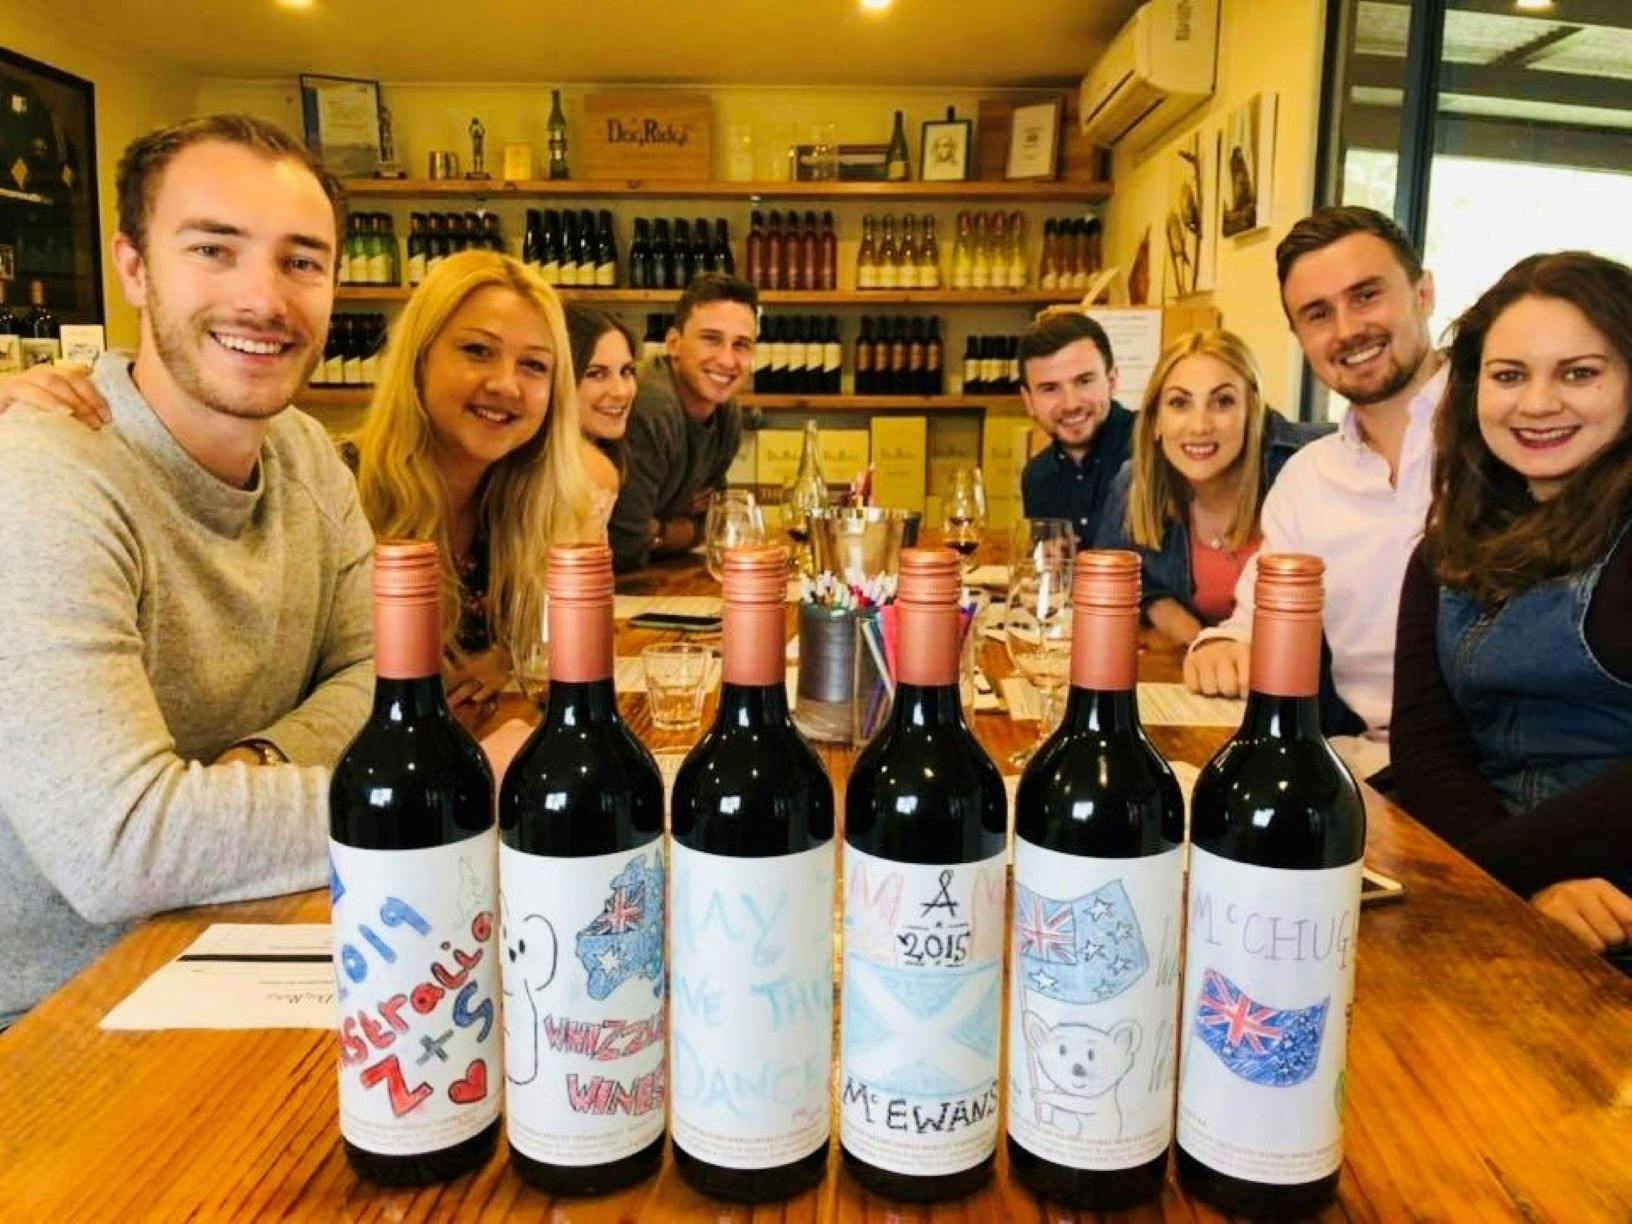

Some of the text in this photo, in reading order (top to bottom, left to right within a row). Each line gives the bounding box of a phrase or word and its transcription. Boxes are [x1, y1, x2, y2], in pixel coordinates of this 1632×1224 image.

[339, 896, 432, 1000] 019
[896, 930, 971, 964] 2015
[543, 1009, 664, 1061] WHIZZ
[565, 1066, 664, 1116] WINE
